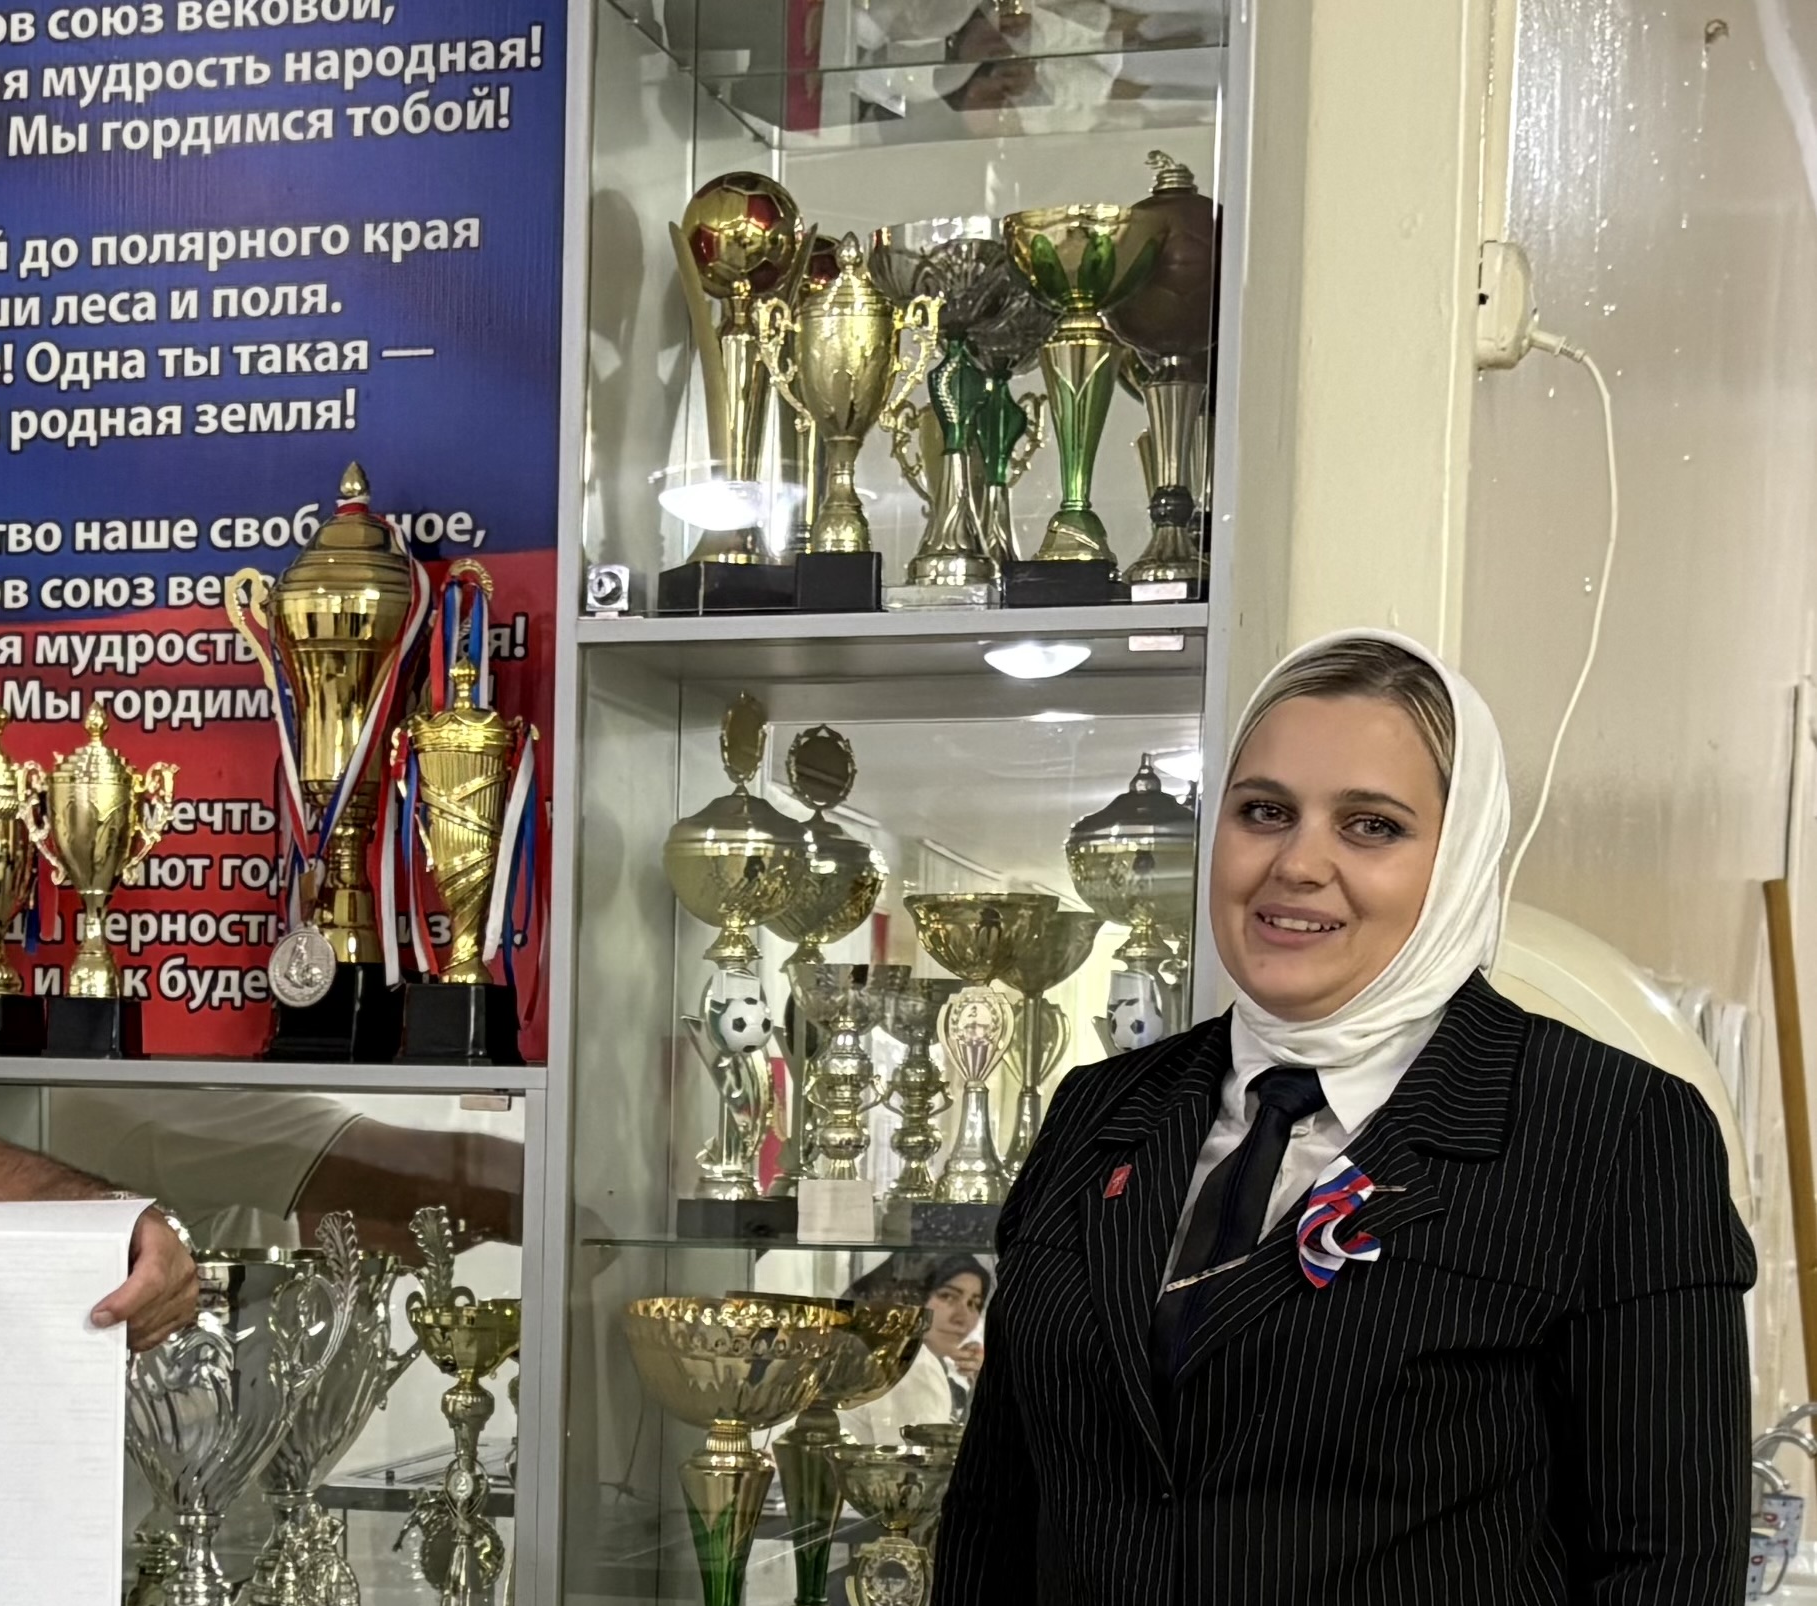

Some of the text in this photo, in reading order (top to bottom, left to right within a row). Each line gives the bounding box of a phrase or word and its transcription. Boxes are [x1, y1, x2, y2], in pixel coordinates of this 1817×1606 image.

[48, 3, 163, 41] союз
[42, 55, 271, 107] мудрость
[285, 25, 543, 90] народная!
[8, 115, 87, 156] Мы
[102, 107, 333, 159] гордимся
[346, 86, 511, 137] тобой!
[19, 237, 79, 278] до
[91, 224, 350, 271] полярного
[364, 217, 480, 263] края
[51, 290, 157, 326] леса
[170, 290, 199, 320] и
[213, 283, 342, 318] поля.
[25, 341, 146, 391] Одна
[158, 346, 220, 378] ты
[232, 339, 368, 375] такая
[11, 404, 182, 452] родная
[194, 388, 356, 434] земля!
[75, 517, 199, 552] наше
[210, 502, 487, 549] свобное,
[41, 575, 156, 609] союз
[3, 680, 81, 720] Мы
[94, 688, 276, 730] гордим
[34, 966, 61, 997] и
[159, 957, 268, 1010] буде
